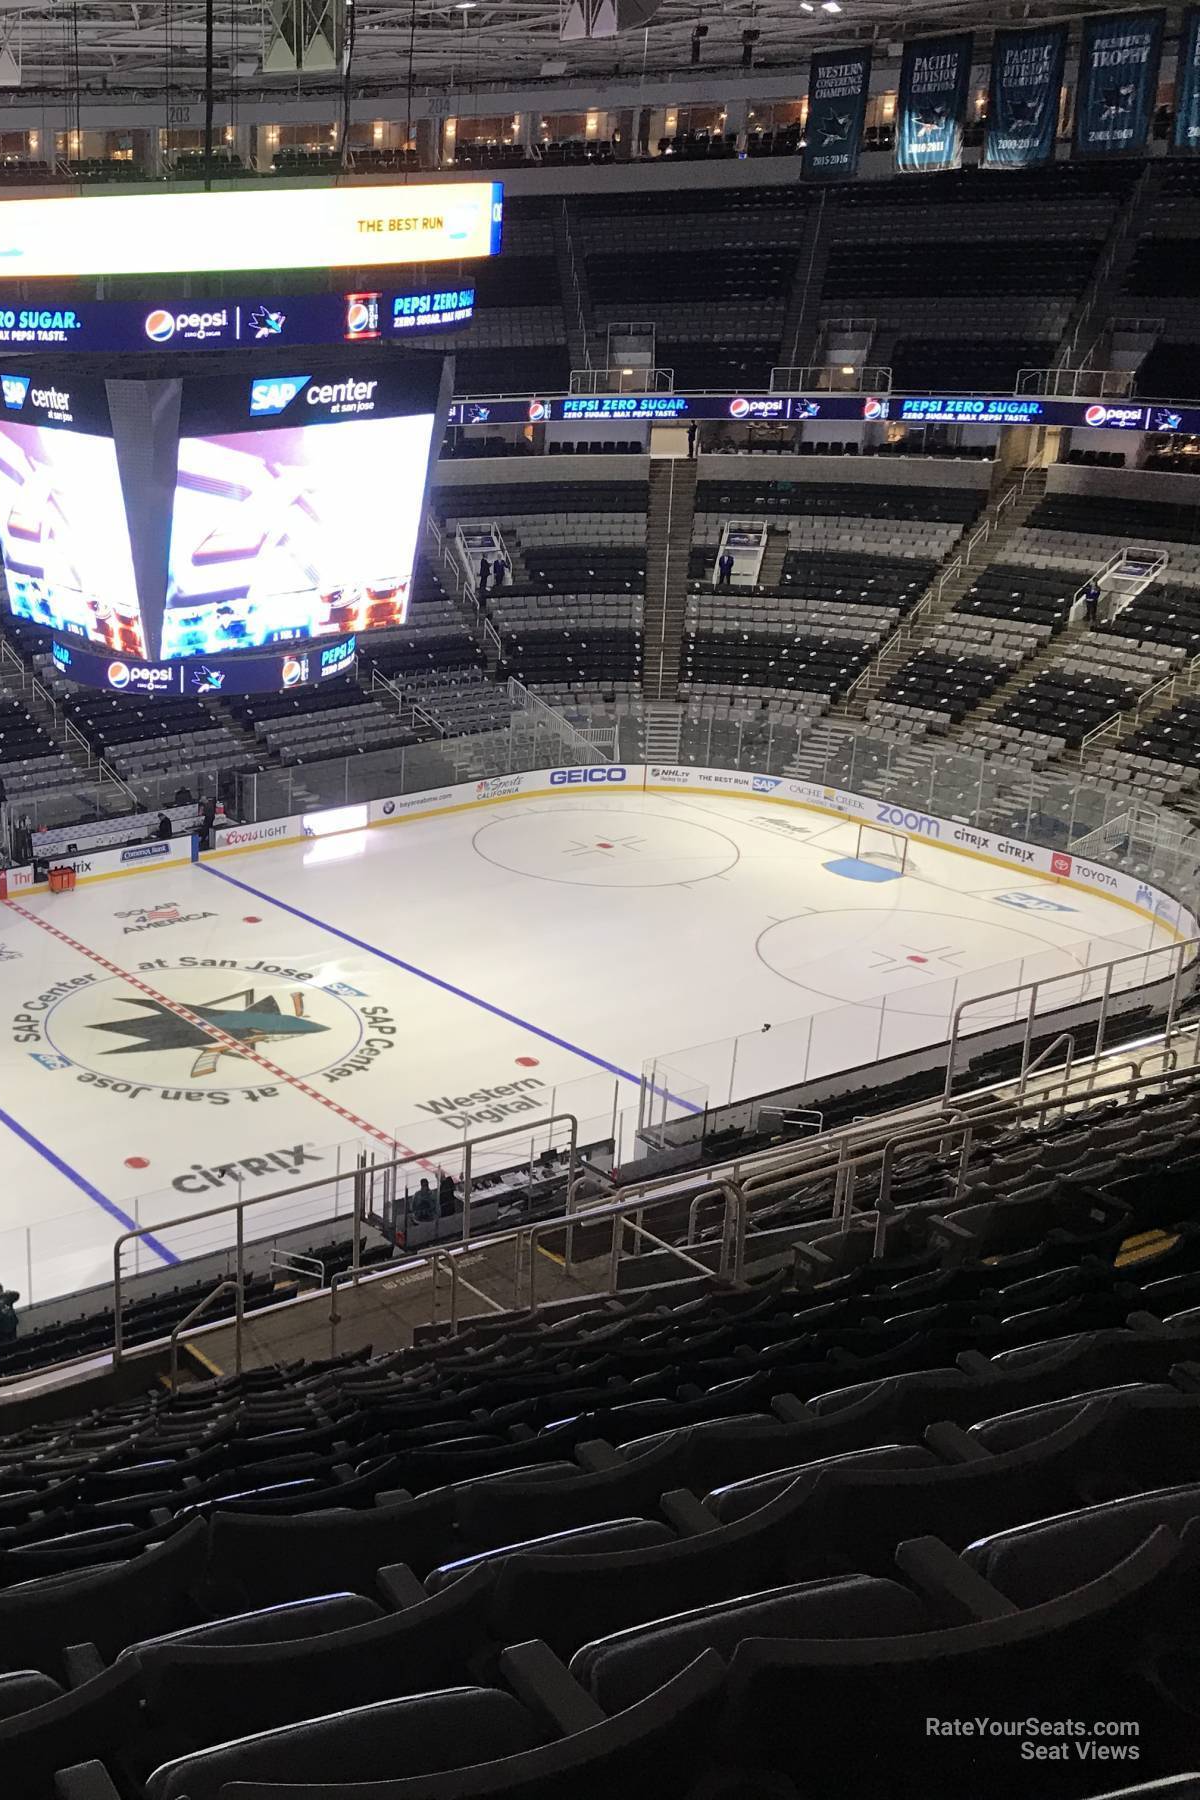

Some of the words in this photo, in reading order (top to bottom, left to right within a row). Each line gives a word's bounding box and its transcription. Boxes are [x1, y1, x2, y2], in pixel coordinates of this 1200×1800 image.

[914, 53, 959, 71] PACIFIC
[1005, 45, 1052, 64] PACIFIC
[1092, 47, 1150, 67] TROPHY
[818, 62, 863, 78] WESTERN
[912, 68, 956, 83] DIVISION
[815, 85, 862, 99] CHAMPIONS
[169, 107, 190, 122] 203
[429, 99, 450, 114] 204
[357, 220, 383, 232] THE
[389, 218, 418, 231] BEST
[422, 217, 444, 229] RUN
[394, 295, 431, 315] PEPSI
[433, 292, 457, 310] ZERO
[19, 311, 81, 328] SUGAR.
[176, 310, 227, 331] pepsi
[393, 316, 415, 328] ZERO
[12, 330, 35, 341] PEPSI
[37, 331, 67, 341] TASTE.
[2, 380, 26, 404] SAP
[31, 387, 69, 410] center
[251, 383, 296, 410] SAP
[307, 378, 377, 404] center
[330, 403, 340, 413] at
[341, 403, 356, 412] san
[357, 401, 375, 413] jose
[563, 401, 598, 411] PEPSI
[602, 400, 638, 411] ZERO
[640, 399, 688, 410] SUGAR.
[749, 400, 782, 412] pepsi
[903, 400, 941, 412] PEPSI
[945, 401, 985, 413] ZERO
[987, 401, 1042, 414] SUGAR.
[613, 410, 631, 418] MAX
[957, 413, 977, 421] MAX
[1106, 409, 1142, 420] pepsi
[322, 643, 347, 666] PEPSI
[130, 667, 172, 681] pepsi
[490, 775, 522, 792] Sports
[550, 768, 626, 784] GEICO
[699, 774, 713, 782] THE
[714, 776, 732, 784] BEST
[734, 778, 749, 786] RUN
[753, 778, 775, 790] SAP
[477, 787, 519, 800] CALIFORNIA
[789, 785, 822, 797] CACHE
[836, 796, 865, 810] CREEK
[876, 803, 940, 838] zoom
[226, 830, 258, 846] Coors
[259, 825, 287, 839] LIGHT
[1075, 865, 1118, 888] TOYOTA
[114, 902, 181, 918] SOLAR
[1001, 892, 1060, 911] SAP
[123, 912, 219, 934] AMERICA
[138, 958, 168, 970] at
[178, 957, 237, 968] San
[245, 960, 314, 981] Jose
[23, 973, 99, 1011] Center
[12, 1014, 41, 1043] SAP
[360, 1006, 397, 1035] SAP
[322, 1038, 394, 1083] Center
[76, 1073, 152, 1099] Jose
[244, 1086, 280, 1103] at
[160, 1088, 230, 1106] San
[414, 1076, 546, 1117] Western
